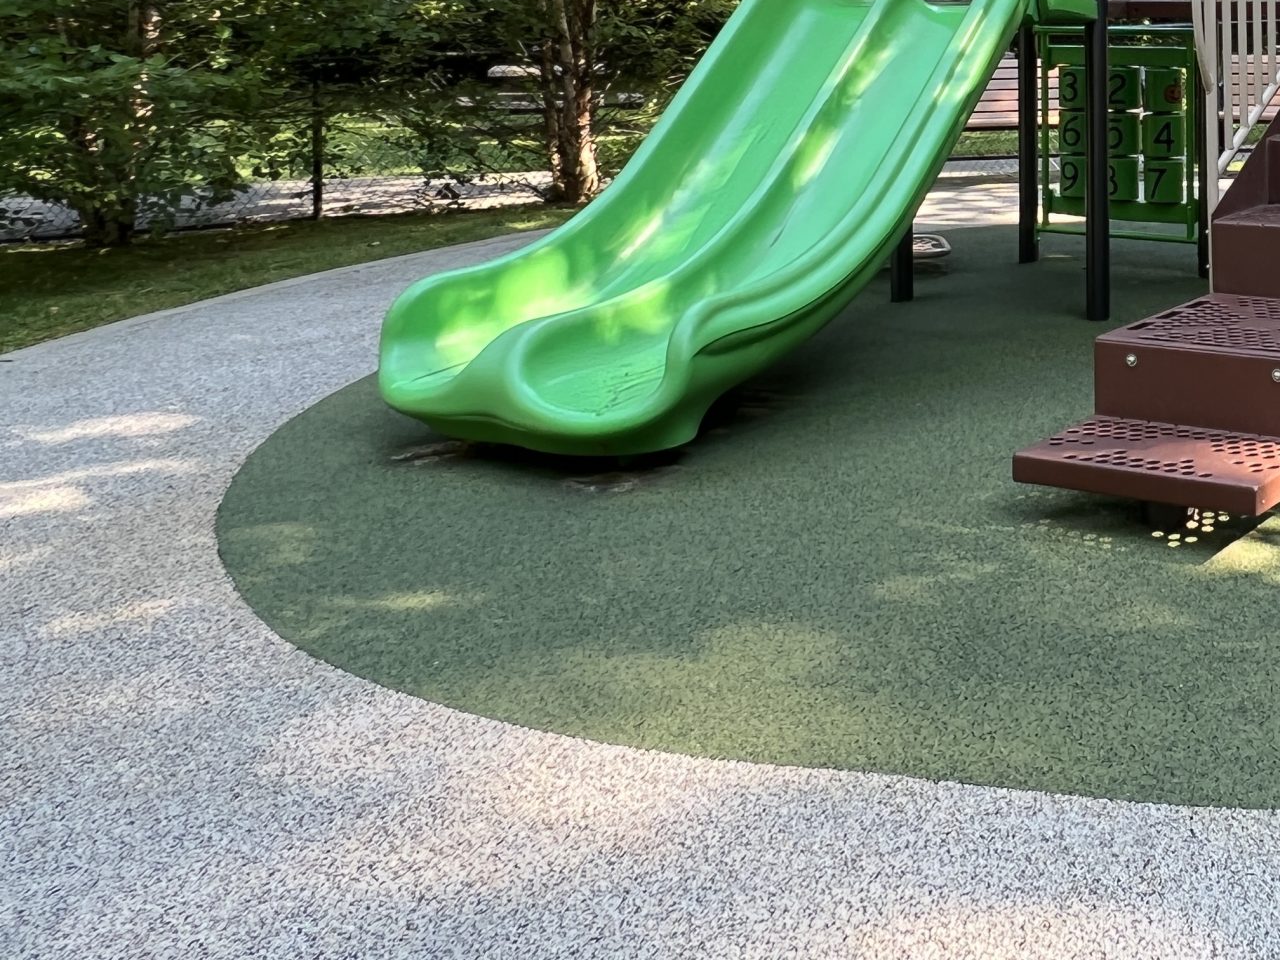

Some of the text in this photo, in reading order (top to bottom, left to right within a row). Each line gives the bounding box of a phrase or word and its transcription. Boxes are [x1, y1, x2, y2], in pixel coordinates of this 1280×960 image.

[1062, 72, 1126, 104] 3 2
[1063, 116, 1080, 147] 6
[1153, 121, 1175, 152] 4
[1062, 162, 1078, 191] 9
[1147, 168, 1167, 199] 7
